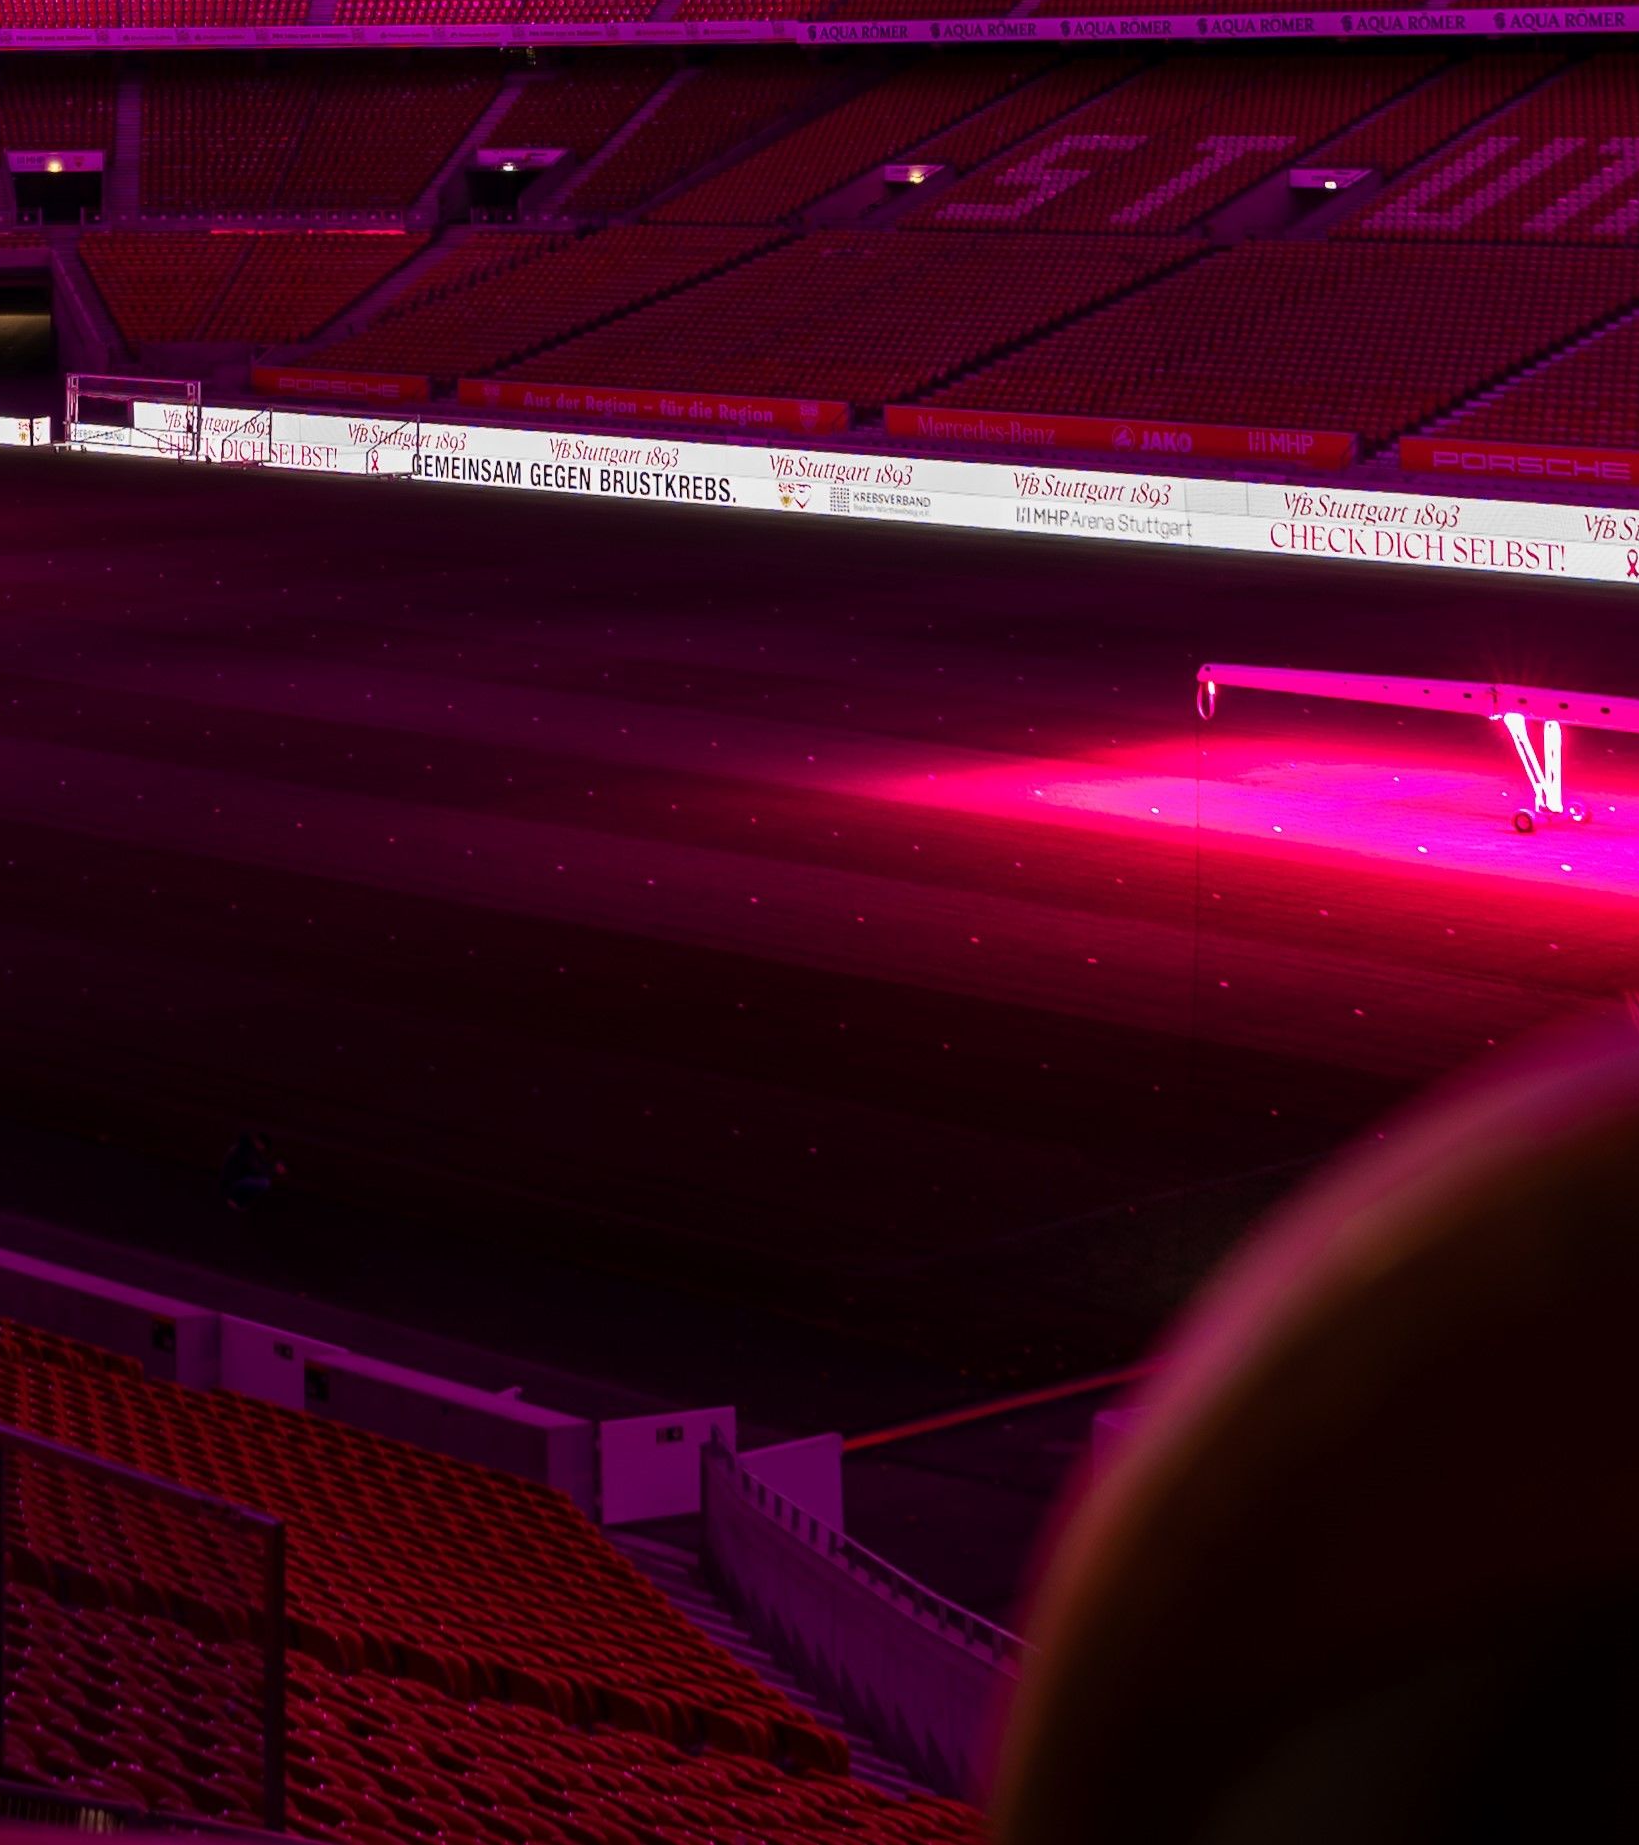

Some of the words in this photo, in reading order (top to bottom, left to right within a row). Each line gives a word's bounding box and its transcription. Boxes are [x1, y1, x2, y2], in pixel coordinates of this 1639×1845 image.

[821, 25, 858, 40] AQUA
[861, 22, 908, 39] RÖMER
[942, 23, 979, 38] AQUA
[984, 20, 1038, 37] RÖMER
[1071, 21, 1116, 36] AQUA
[1120, 17, 1172, 35] RÖMER
[1210, 19, 1258, 35] AQUA
[1262, 16, 1316, 33] RÖMER
[1356, 14, 1404, 31] AQUA
[1407, 11, 1466, 29] RÖMER
[1507, 12, 1560, 29] AQUA
[1564, 9, 1626, 28] RÖMER
[279, 377, 401, 398] PORSCHE
[523, 392, 552, 410] Aus
[556, 393, 580, 411] der
[585, 396, 637, 419] Region
[659, 400, 684, 418] für
[688, 402, 713, 420] die
[720, 404, 774, 426] Region
[436, 430, 467, 454] 1893
[918, 415, 1056, 445] Mercedes-Benz
[1140, 432, 1193, 453] JAKO
[1267, 433, 1314, 455] MHP
[223, 439, 263, 461] DICH
[271, 441, 337, 469] SELBST!
[549, 436, 571, 460] VfB
[572, 440, 641, 468] Stuttgart
[646, 447, 680, 473] 1893
[1432, 452, 1632, 481] PORSCHE
[412, 454, 521, 485] GEMEINSAM
[530, 462, 591, 492] GEGEN
[600, 469, 737, 504] BRUSTKREBS.
[769, 454, 794, 479] VfB
[795, 456, 872, 484] Stuttgart
[875, 463, 913, 488] 1893
[853, 492, 931, 508] KREBSVERBAND
[1013, 471, 1040, 497] VfB
[1042, 472, 1127, 505] Stuttgart
[1130, 482, 1172, 508] 1893
[1284, 491, 1315, 522] VfB
[1317, 493, 1410, 528] Stuttgart
[1414, 503, 1460, 532] 1893
[1118, 514, 1193, 540] Stuttgart
[1584, 513, 1619, 545] VfB
[1270, 523, 1368, 556] CHECK
[1375, 530, 1446, 563] DICH
[1451, 537, 1567, 572] SELBST!
